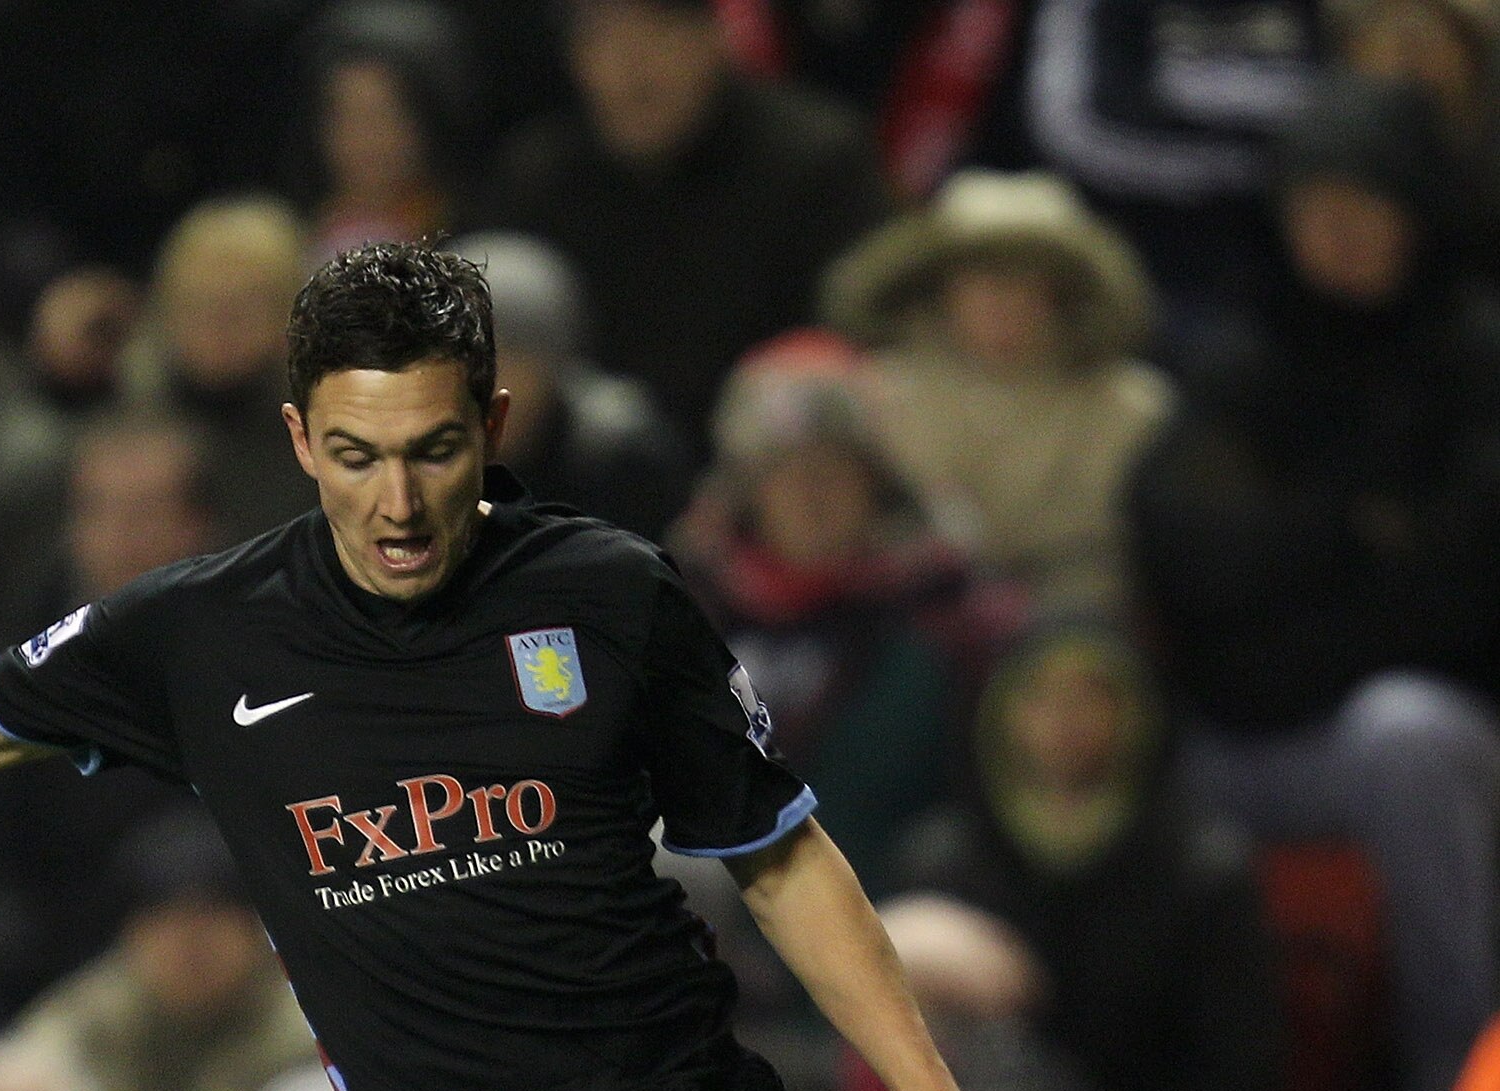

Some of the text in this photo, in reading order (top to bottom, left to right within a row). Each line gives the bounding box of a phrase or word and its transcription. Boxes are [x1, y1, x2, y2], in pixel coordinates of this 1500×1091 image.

[518, 631, 571, 651] AVFC
[284, 774, 556, 876] FxPro
[314, 838, 566, 911] Trade Forex Like a Pro
